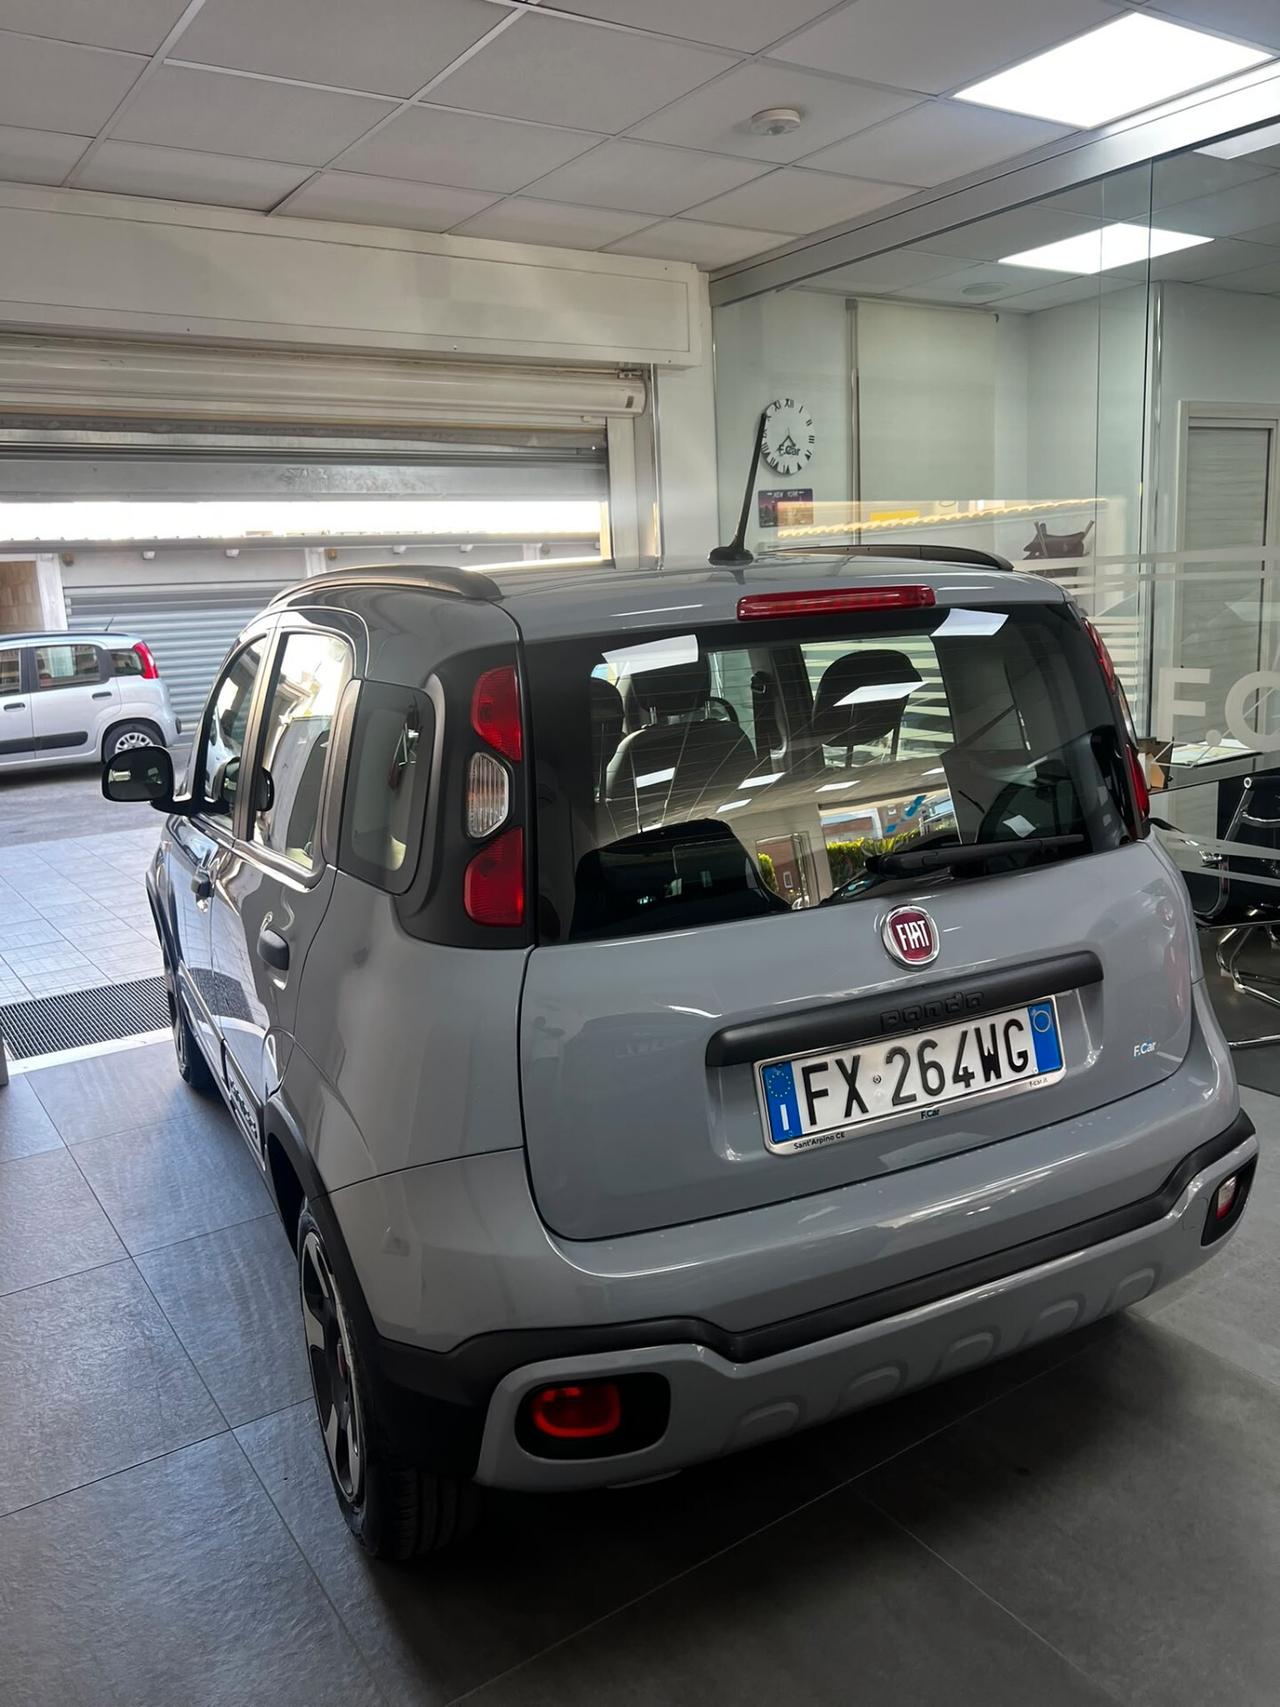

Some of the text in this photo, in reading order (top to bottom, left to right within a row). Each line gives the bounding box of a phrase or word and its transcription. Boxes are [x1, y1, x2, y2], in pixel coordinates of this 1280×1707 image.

[896, 920, 930, 951] FIAT
[1133, 1041, 1157, 1057] F.Car
[801, 1019, 1029, 1126] FX 264WG
[836, 1131, 845, 1140] CE
